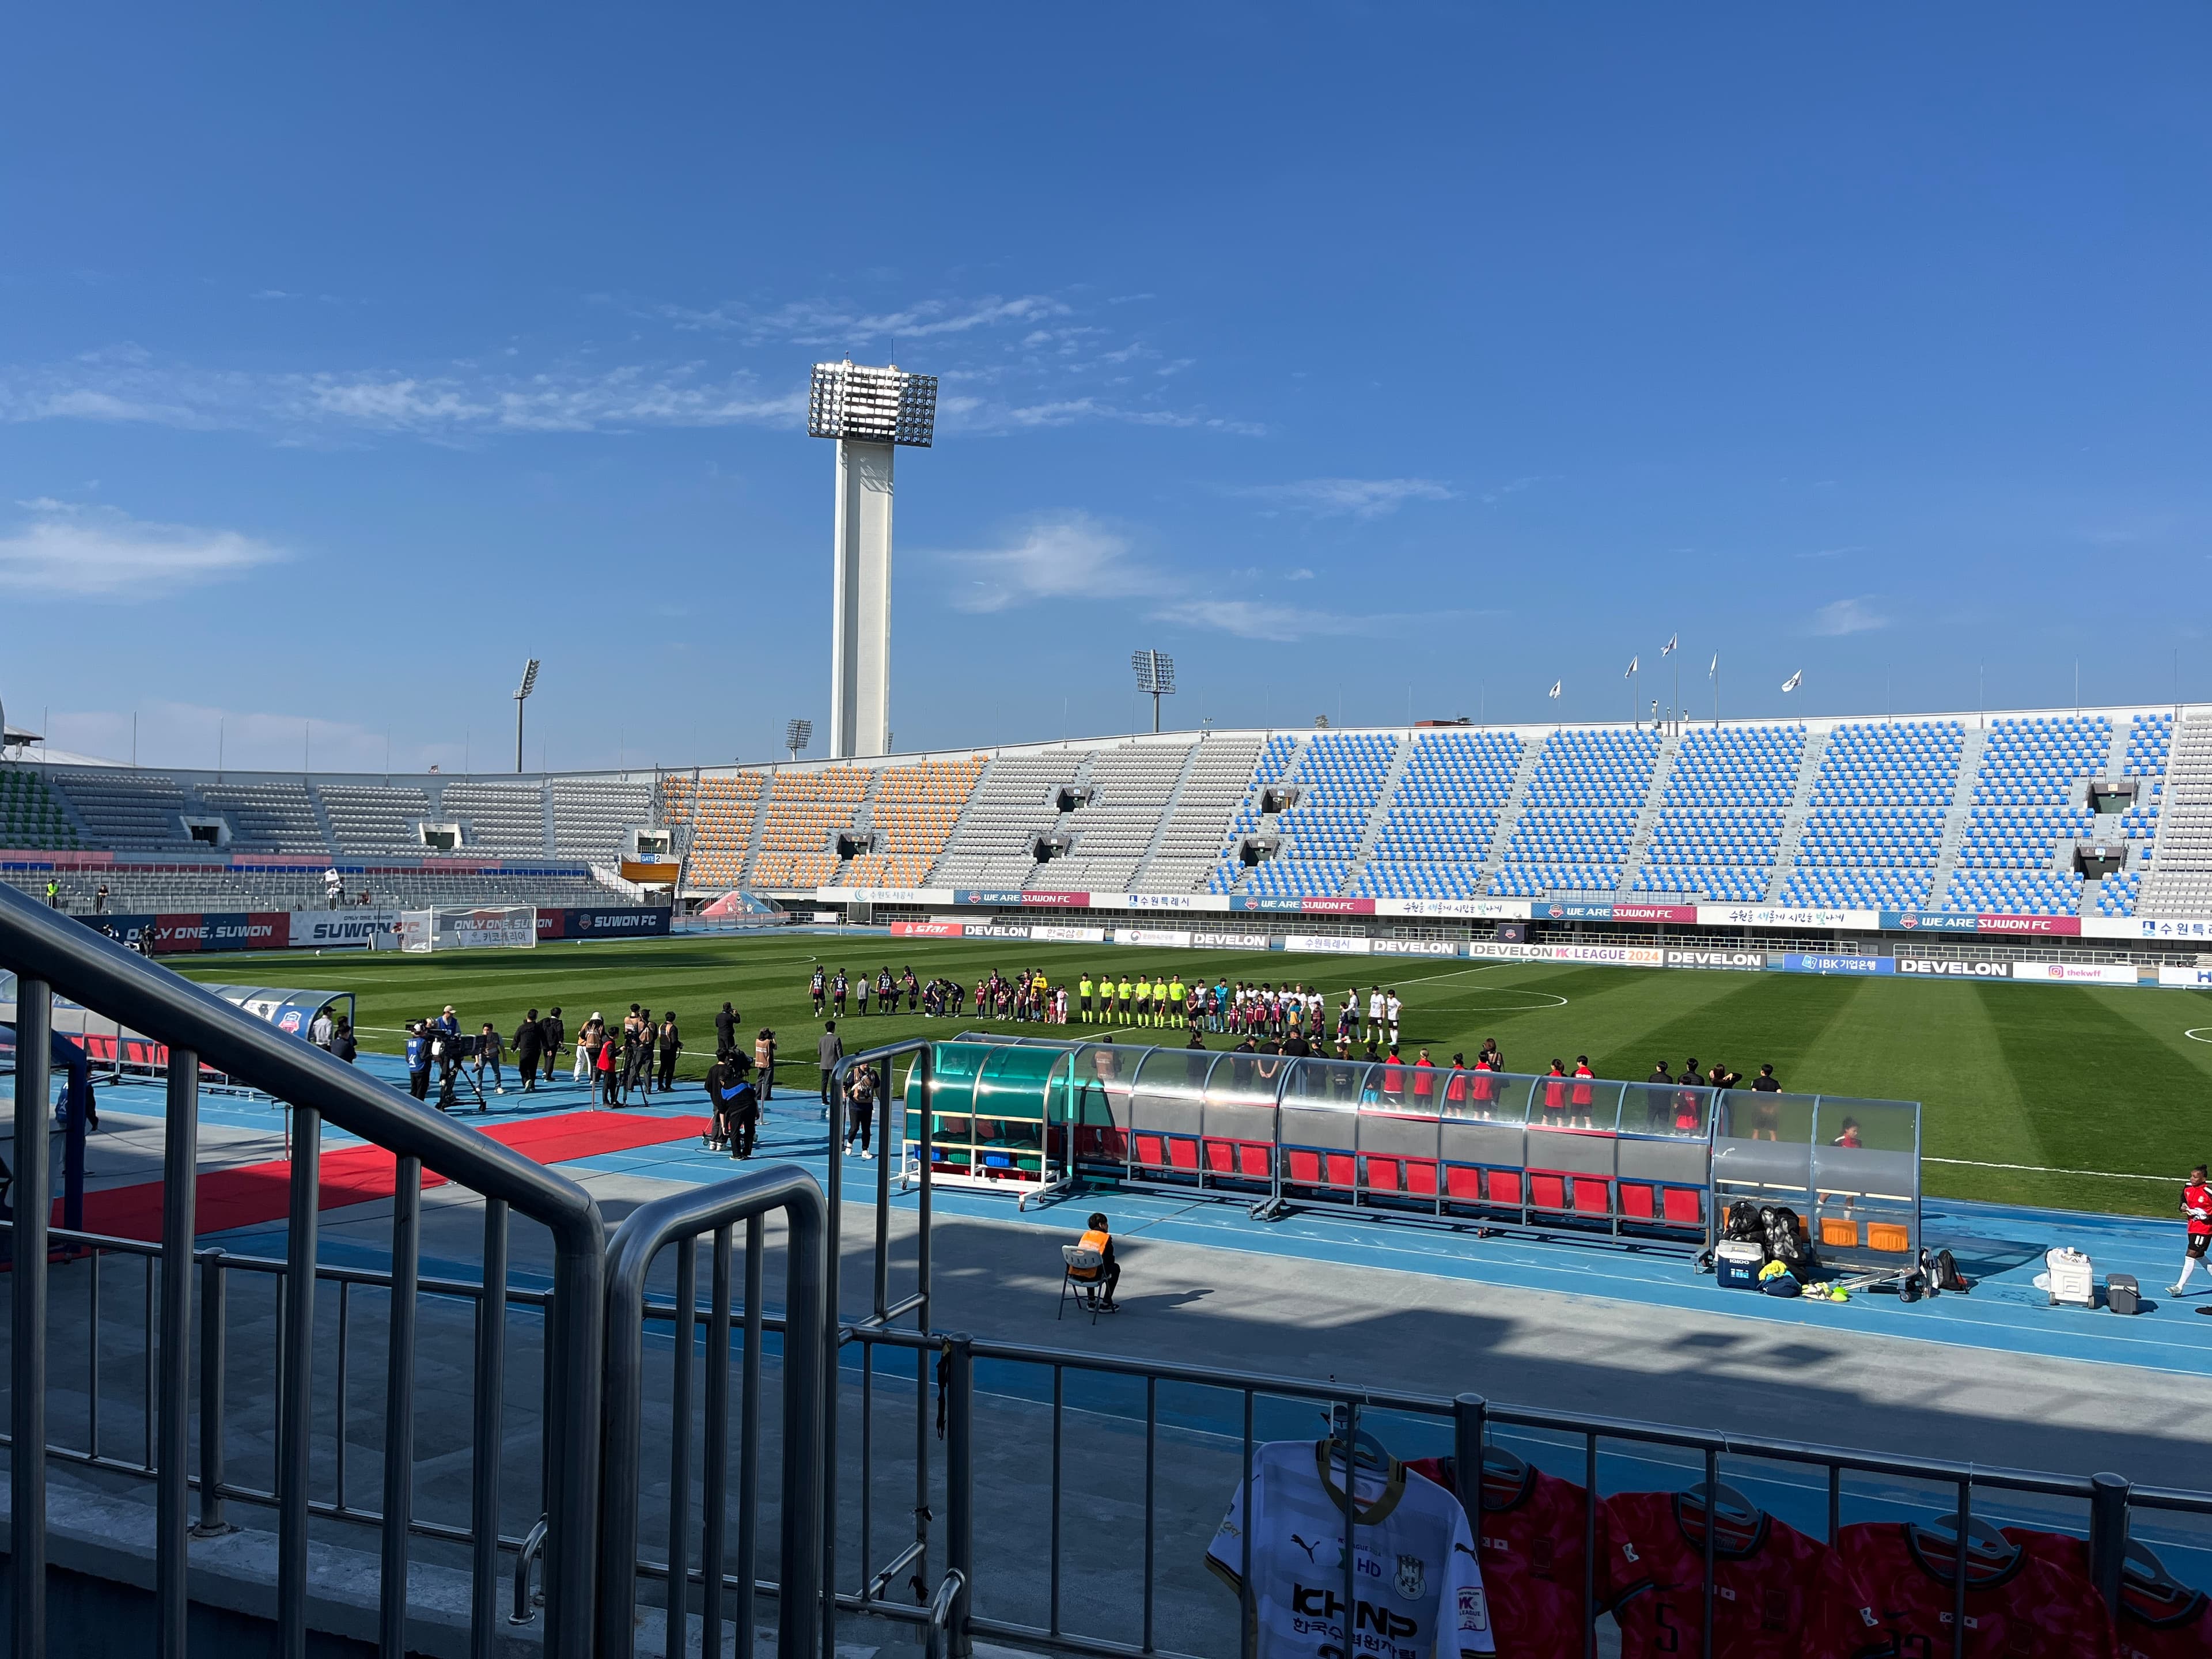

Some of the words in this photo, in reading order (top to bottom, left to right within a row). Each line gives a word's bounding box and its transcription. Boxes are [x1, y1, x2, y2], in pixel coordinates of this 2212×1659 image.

[870, 892, 914, 900] 수원도시공사
[1021, 895, 1056, 903] SUWON
[1056, 895, 1071, 903] FC
[1141, 896, 1190, 907] 수원특례시
[1261, 900, 1278, 908] WE
[1278, 900, 1300, 908] ARE
[1301, 901, 1339, 910] SUWON
[1340, 902, 1354, 910] FC
[1403, 902, 1425, 912] 수원을
[1454, 903, 1475, 913] 시민을
[1478, 903, 1502, 915] 빛나게
[1566, 908, 1585, 916] WE
[1585, 908, 1611, 916] ARE
[1612, 908, 1655, 918] SUWON
[1656, 910, 1673, 918] FC
[1729, 910, 1753, 922] 수원을
[1757, 911, 1785, 923] 새롭게
[1789, 912, 1813, 923] 시민을
[1816, 912, 1844, 925] 빛나게
[454, 920, 486, 930] ONLY
[513, 918, 552, 929] SUWON
[594, 915, 639, 927] SUWON
[641, 915, 657, 926] FC
[1922, 917, 1944, 926] WE
[1945, 918, 1975, 927] ARE
[1977, 919, 2030, 929] SUWON
[2031, 921, 2051, 930] FC
[215, 925, 272, 937] SUWON
[313, 922, 391, 939] SUWON
[965, 926, 1028, 937] DEVELON
[1194, 934, 1266, 946] DEVELON
[1305, 938, 1350, 949] 수원특례시
[1373, 940, 1454, 954] DEVELON
[1474, 945, 1552, 957] DEVELON
[1574, 948, 1626, 960] LEAGUE
[1628, 950, 1659, 961] 2024
[1668, 952, 1761, 966] DEVELON
[1819, 959, 1839, 968] IBK
[1840, 960, 1876, 971] 기업은행
[1901, 960, 2007, 976] DEVELON
[2067, 969, 2101, 978] thekwff
[2194, 1235, 2204, 1245] 11
[1357, 1557, 1381, 1577] HD
